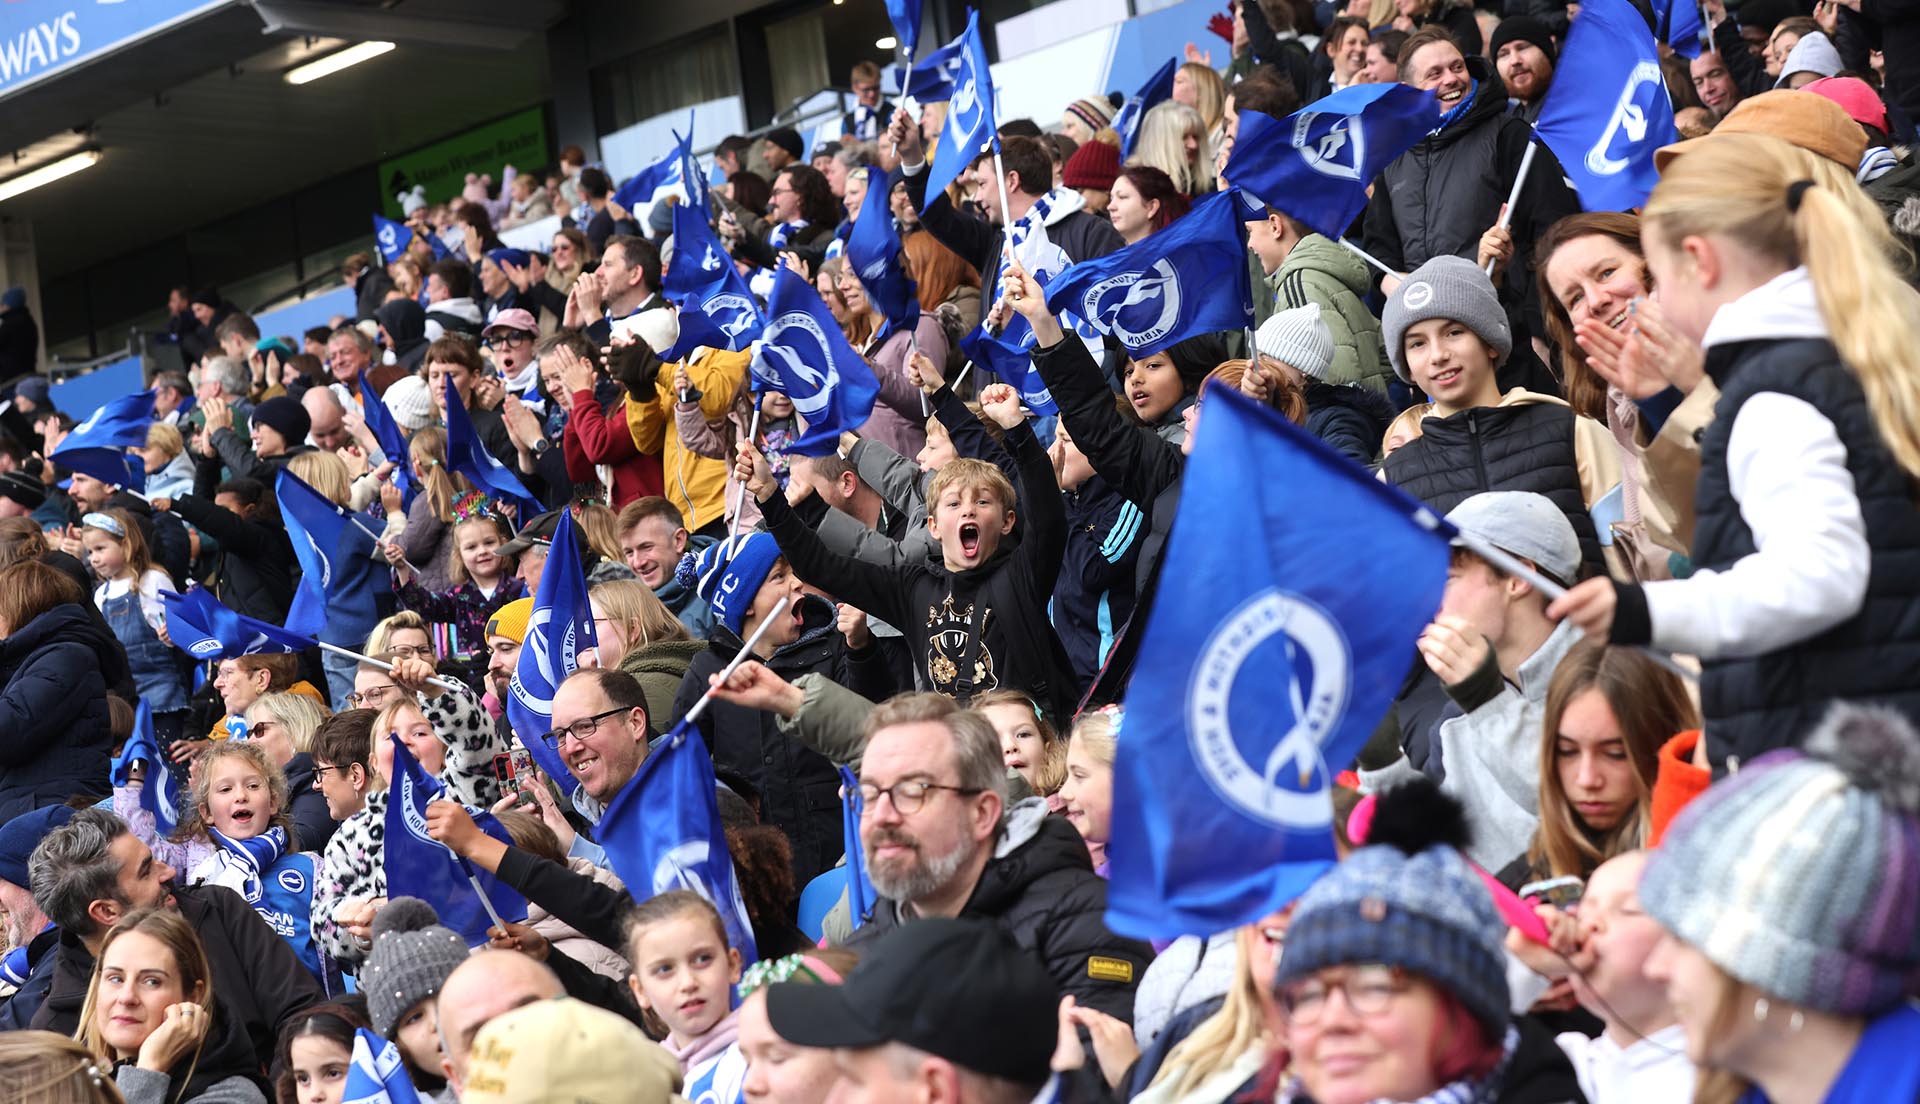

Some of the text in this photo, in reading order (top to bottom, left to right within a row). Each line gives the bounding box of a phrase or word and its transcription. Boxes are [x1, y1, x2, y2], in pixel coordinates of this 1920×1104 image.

[0, 10, 81, 83] WAYS
[274, 911, 294, 926] AN
[277, 924, 296, 937] SS
